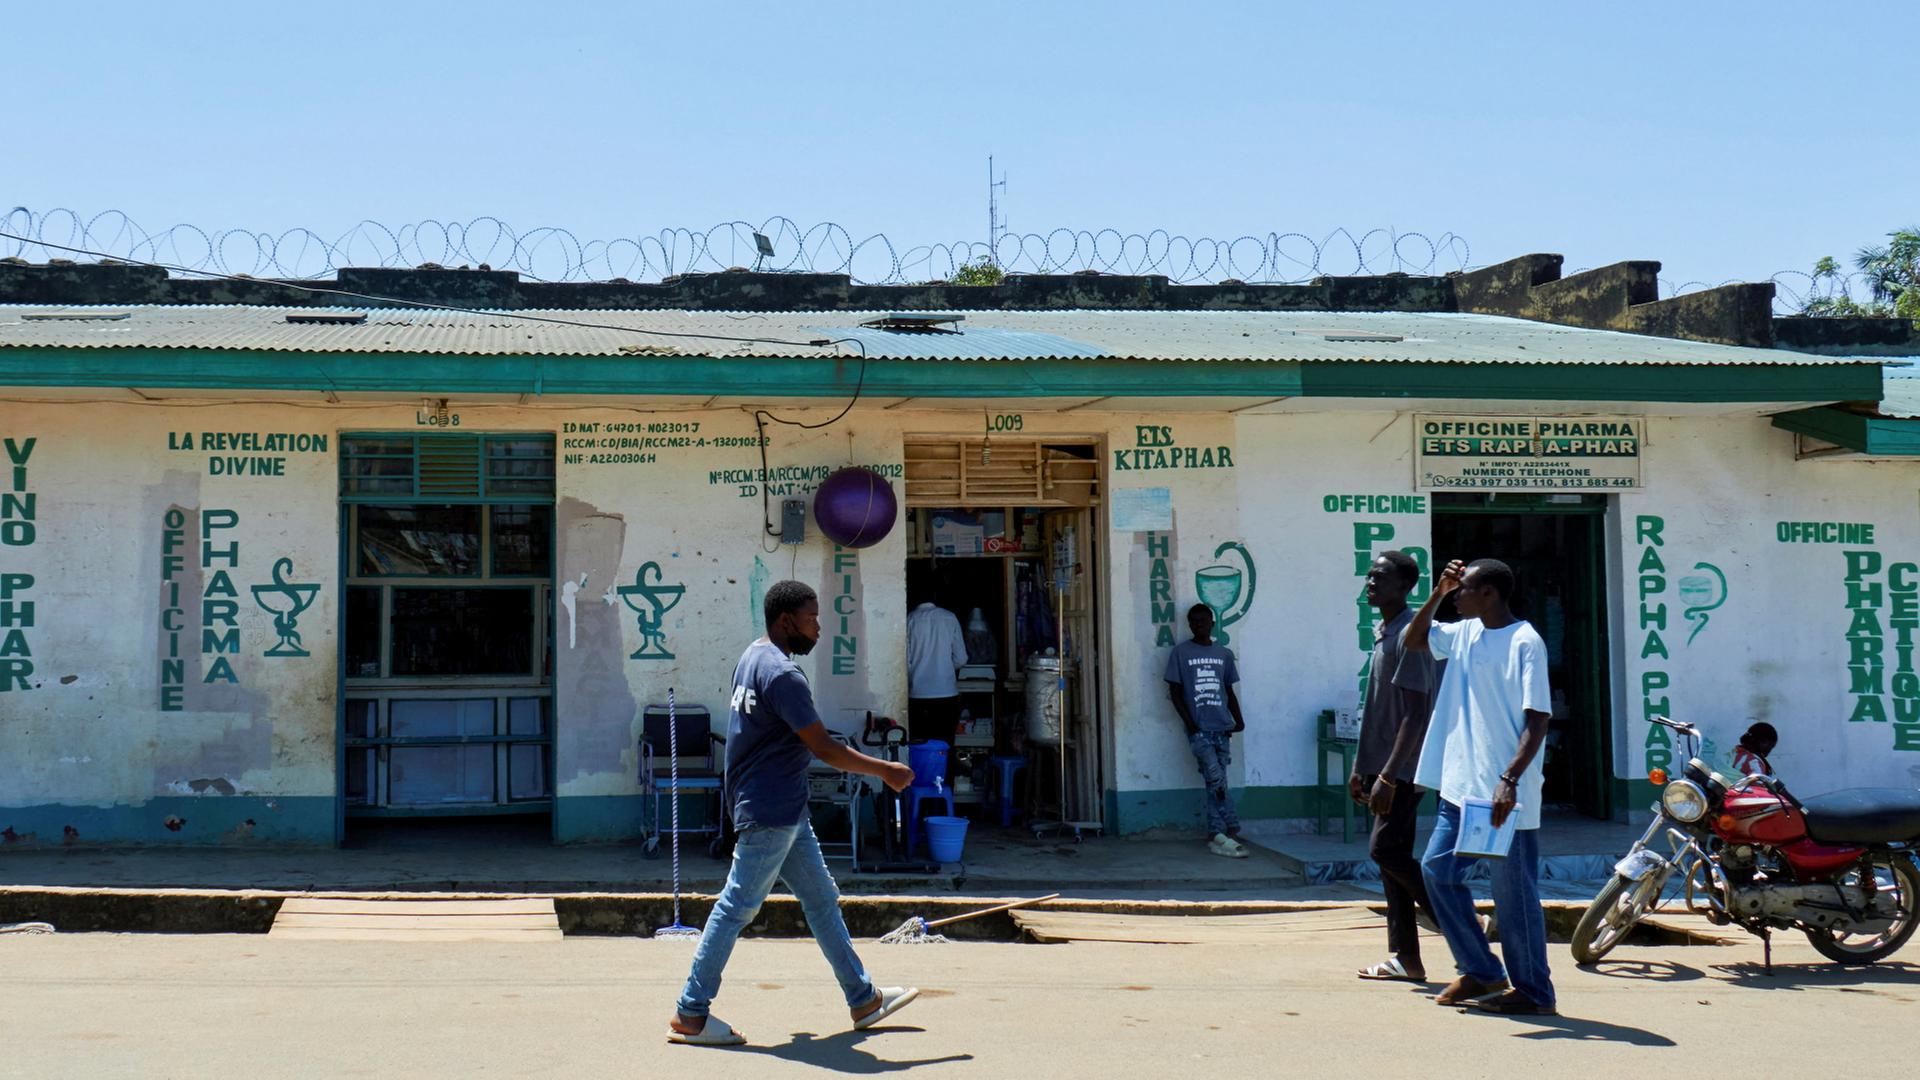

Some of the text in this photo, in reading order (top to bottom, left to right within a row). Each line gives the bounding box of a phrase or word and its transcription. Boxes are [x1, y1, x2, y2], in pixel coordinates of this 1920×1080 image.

[563, 423, 577, 433] ID
[1424, 422, 1634, 436] OFFICINE PHARMA
[168, 432, 328, 452] LA REVELATION
[1425, 439, 1471, 453] ETS
[209, 456, 286, 476] DIVINE
[1114, 446, 1234, 470] KITAPHAR
[739, 485, 758, 498] ID
[1447, 478, 1634, 488] +243 997 039 110, 813 685 441
[1323, 494, 1426, 515] OFFICINE
[1776, 521, 1875, 545] OFFICINE
[0, 438, 37, 692] VINO PHAR
[202, 509, 241, 684] PHARMA
[1147, 531, 1176, 647] HARMA
[1635, 514, 1669, 661] RAPHA
[161, 508, 185, 712] OFFICINE
[832, 545, 857, 676] FICINE
[1842, 550, 1888, 722] PHARMA
[1887, 562, 1920, 752] CETIQUE
